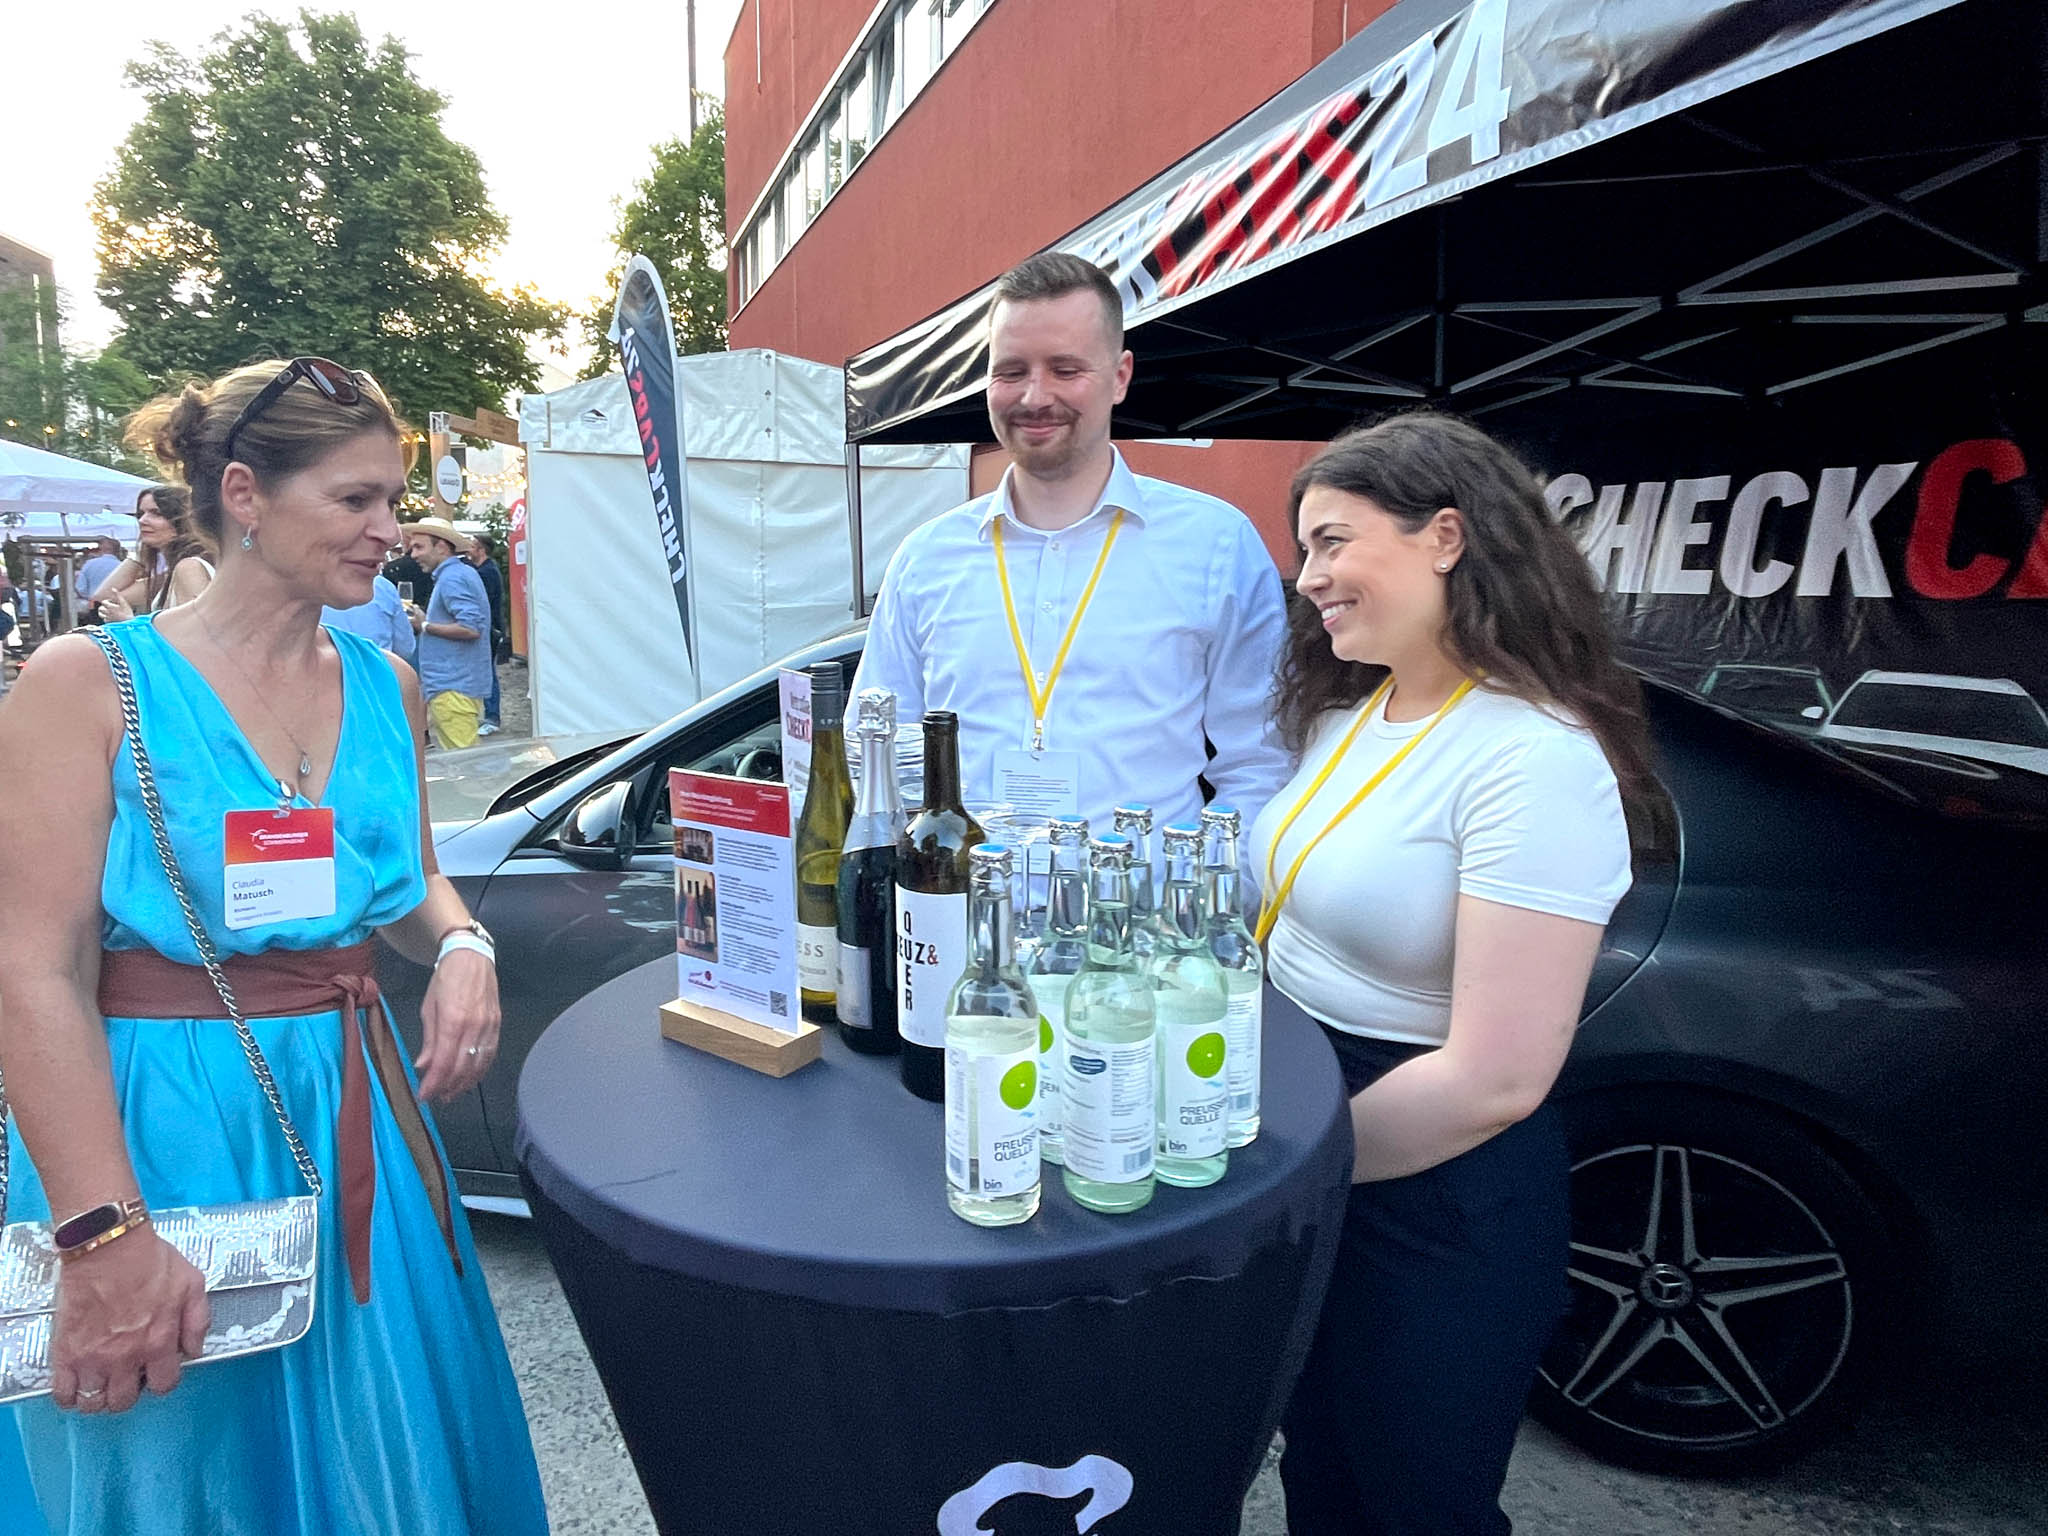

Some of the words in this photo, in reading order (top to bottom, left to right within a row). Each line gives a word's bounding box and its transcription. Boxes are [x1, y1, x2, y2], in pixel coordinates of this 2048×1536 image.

[1544, 438, 2048, 600] HECKC
[232, 878, 265, 890] Claudia
[233, 888, 274, 901] Matusch
